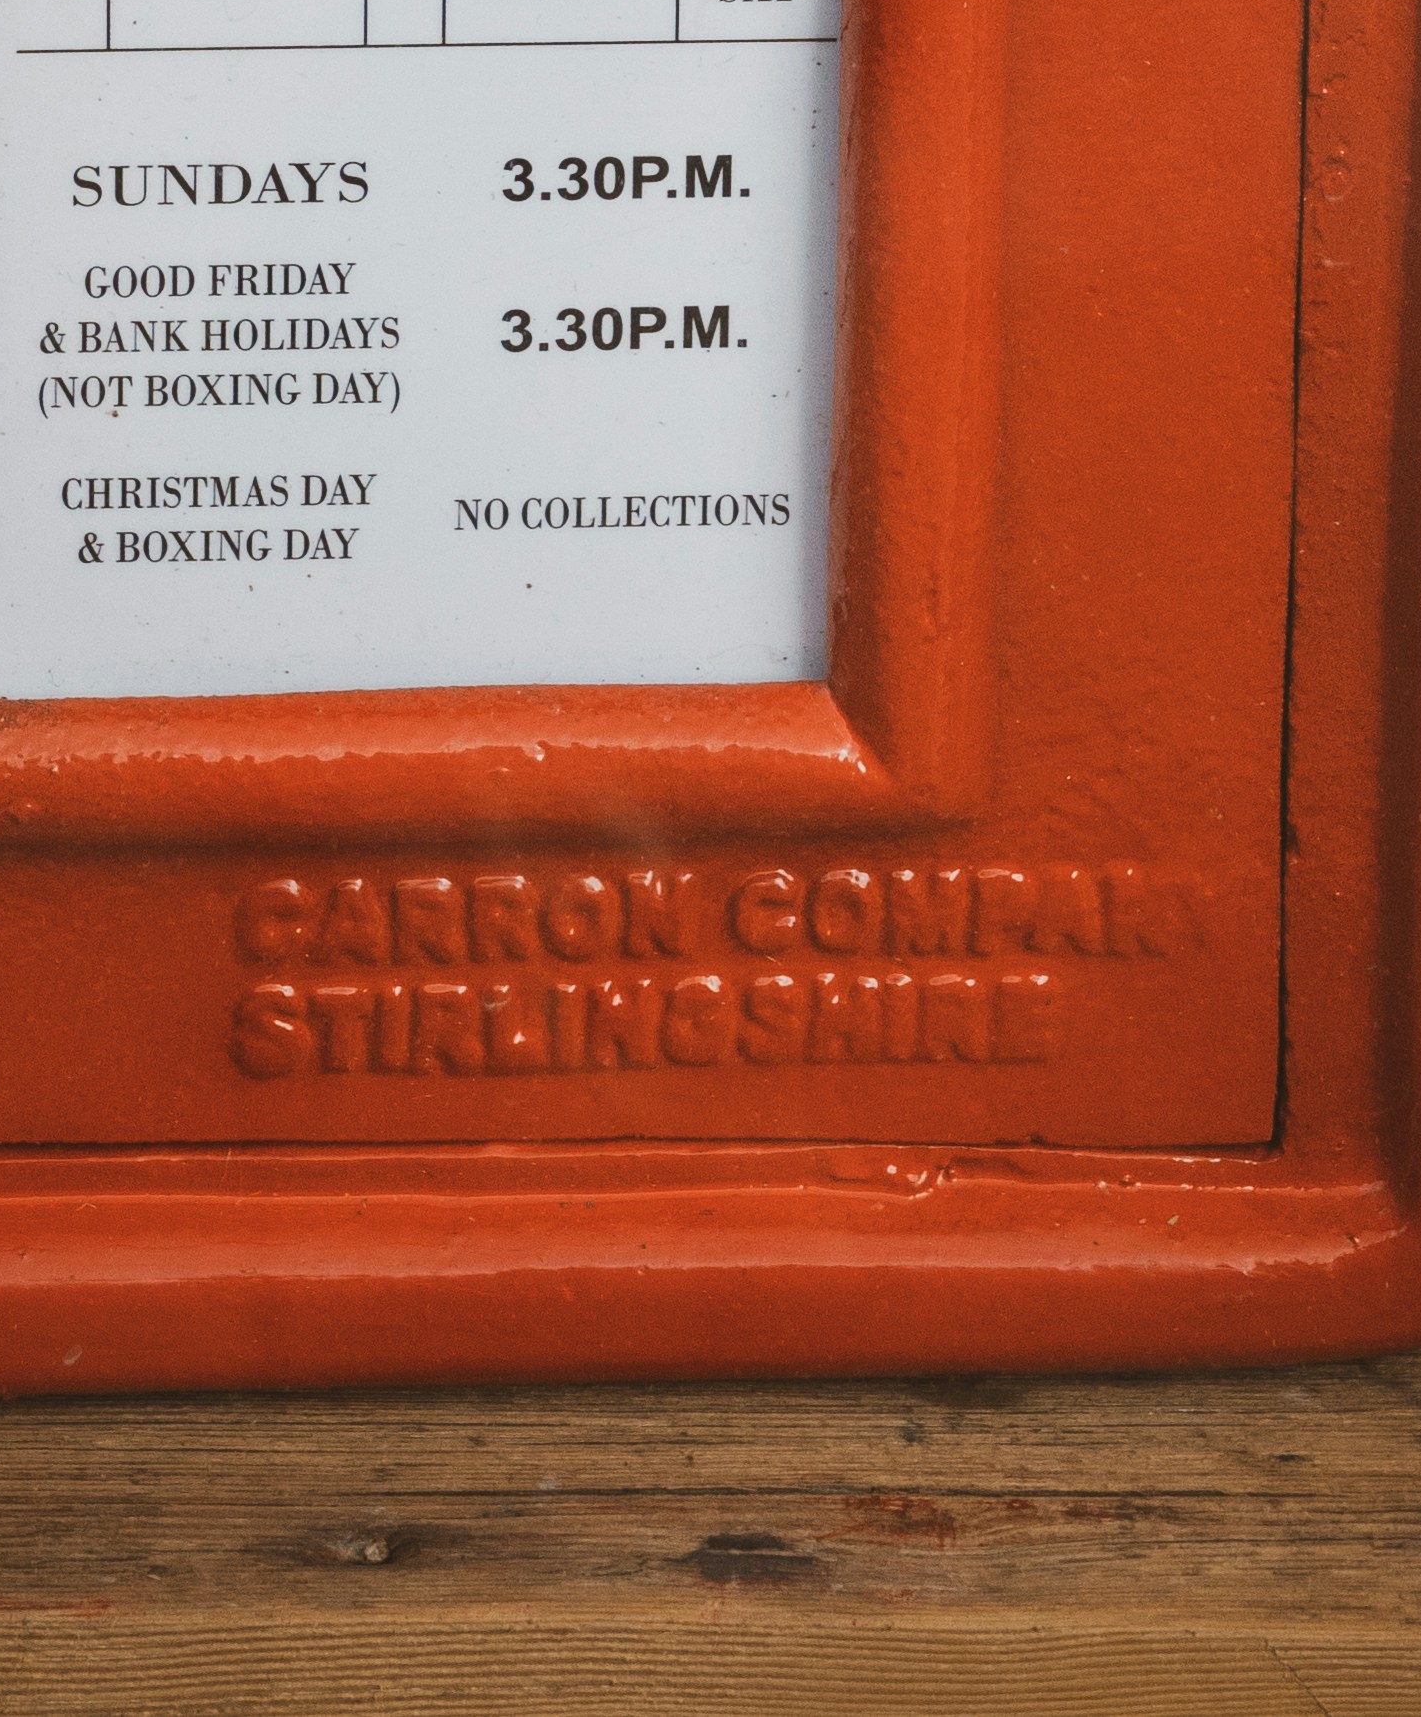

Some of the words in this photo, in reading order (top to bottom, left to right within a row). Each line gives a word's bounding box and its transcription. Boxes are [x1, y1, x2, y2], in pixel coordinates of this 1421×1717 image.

[71, 160, 370, 209] SUNDAYS
[501, 153, 751, 203] 3.30P.M.
[83, 264, 196, 300] GOOD
[207, 261, 357, 298] FRIDAY
[38, 321, 66, 355] &
[77, 319, 190, 355] BANK
[200, 315, 401, 353] HOLIDAYS
[499, 304, 749, 354] 3.30P.M.
[37, 374, 134, 420] (NOT
[143, 371, 302, 408] BOXING
[311, 370, 402, 415] DAY)
[60, 473, 290, 512] CHRISTMAS
[299, 473, 374, 507] DAY
[453, 497, 510, 531] NO
[520, 492, 791, 531] COLLECTIONS
[77, 531, 106, 565] &
[114, 527, 273, 564] BOXING
[282, 526, 361, 562] DAY
[232, 872, 702, 966] CARRON
[228, 970, 1056, 1081] STIRLINGSHIRE
